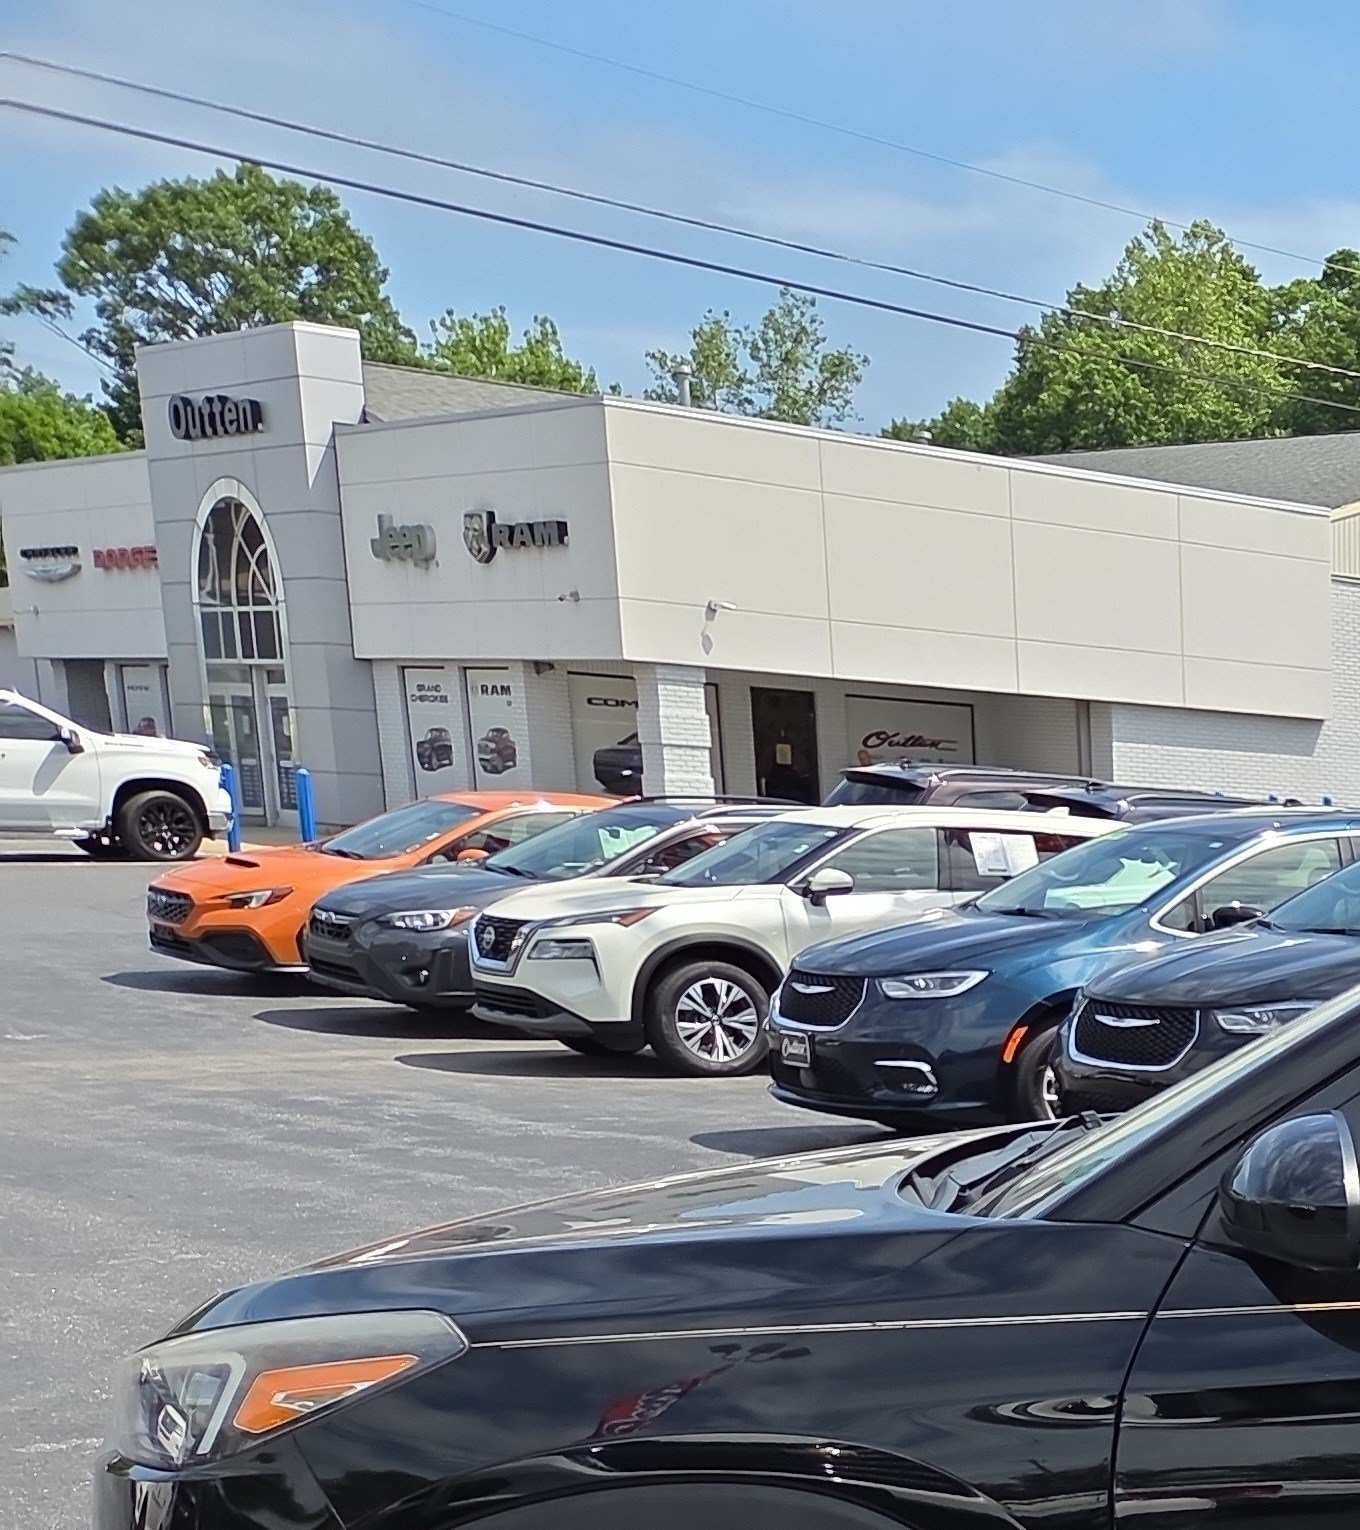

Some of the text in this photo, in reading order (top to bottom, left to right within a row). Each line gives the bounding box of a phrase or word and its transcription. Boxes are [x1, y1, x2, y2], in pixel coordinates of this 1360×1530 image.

[168, 394, 263, 440] Outten
[370, 513, 438, 570] Jeep
[491, 520, 568, 550] RAM
[480, 684, 511, 696] RAM
